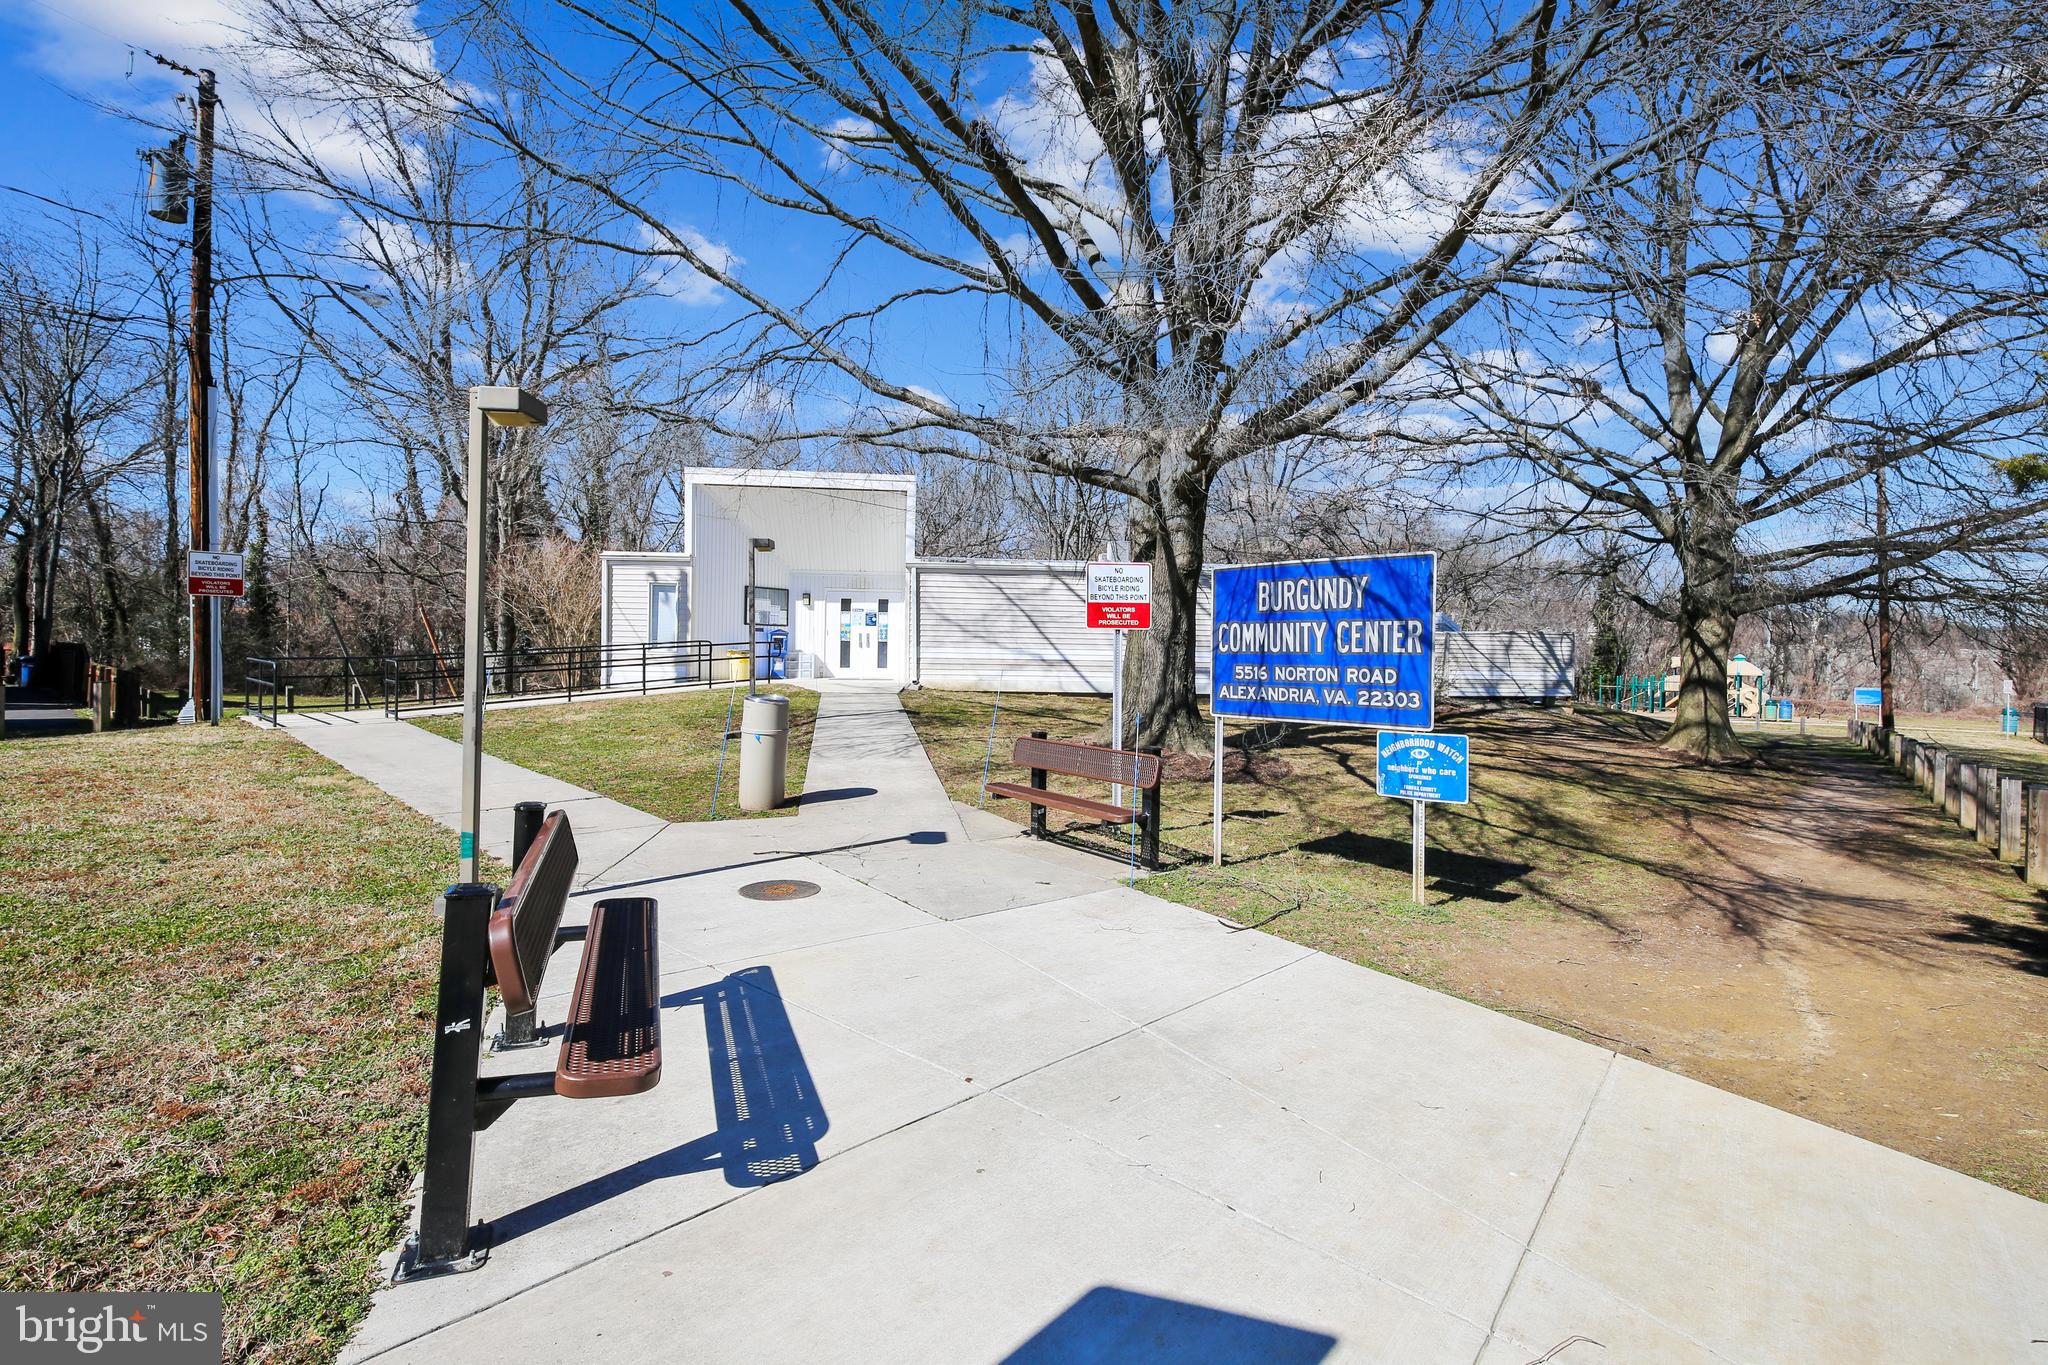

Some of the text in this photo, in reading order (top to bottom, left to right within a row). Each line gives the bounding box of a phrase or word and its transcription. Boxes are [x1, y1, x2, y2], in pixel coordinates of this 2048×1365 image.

[1258, 575, 1368, 612] BURGUNDY
[1218, 620, 1424, 654] COMMUNITY CENTER
[1235, 665, 1397, 684] 5516 NORTON ROAD
[1219, 686, 1421, 708] ALEXANDRIA, VA. 22303
[1381, 738, 1464, 764] NEIGHBORHOOD WATCH
[1387, 764, 1419, 773] neighbors
